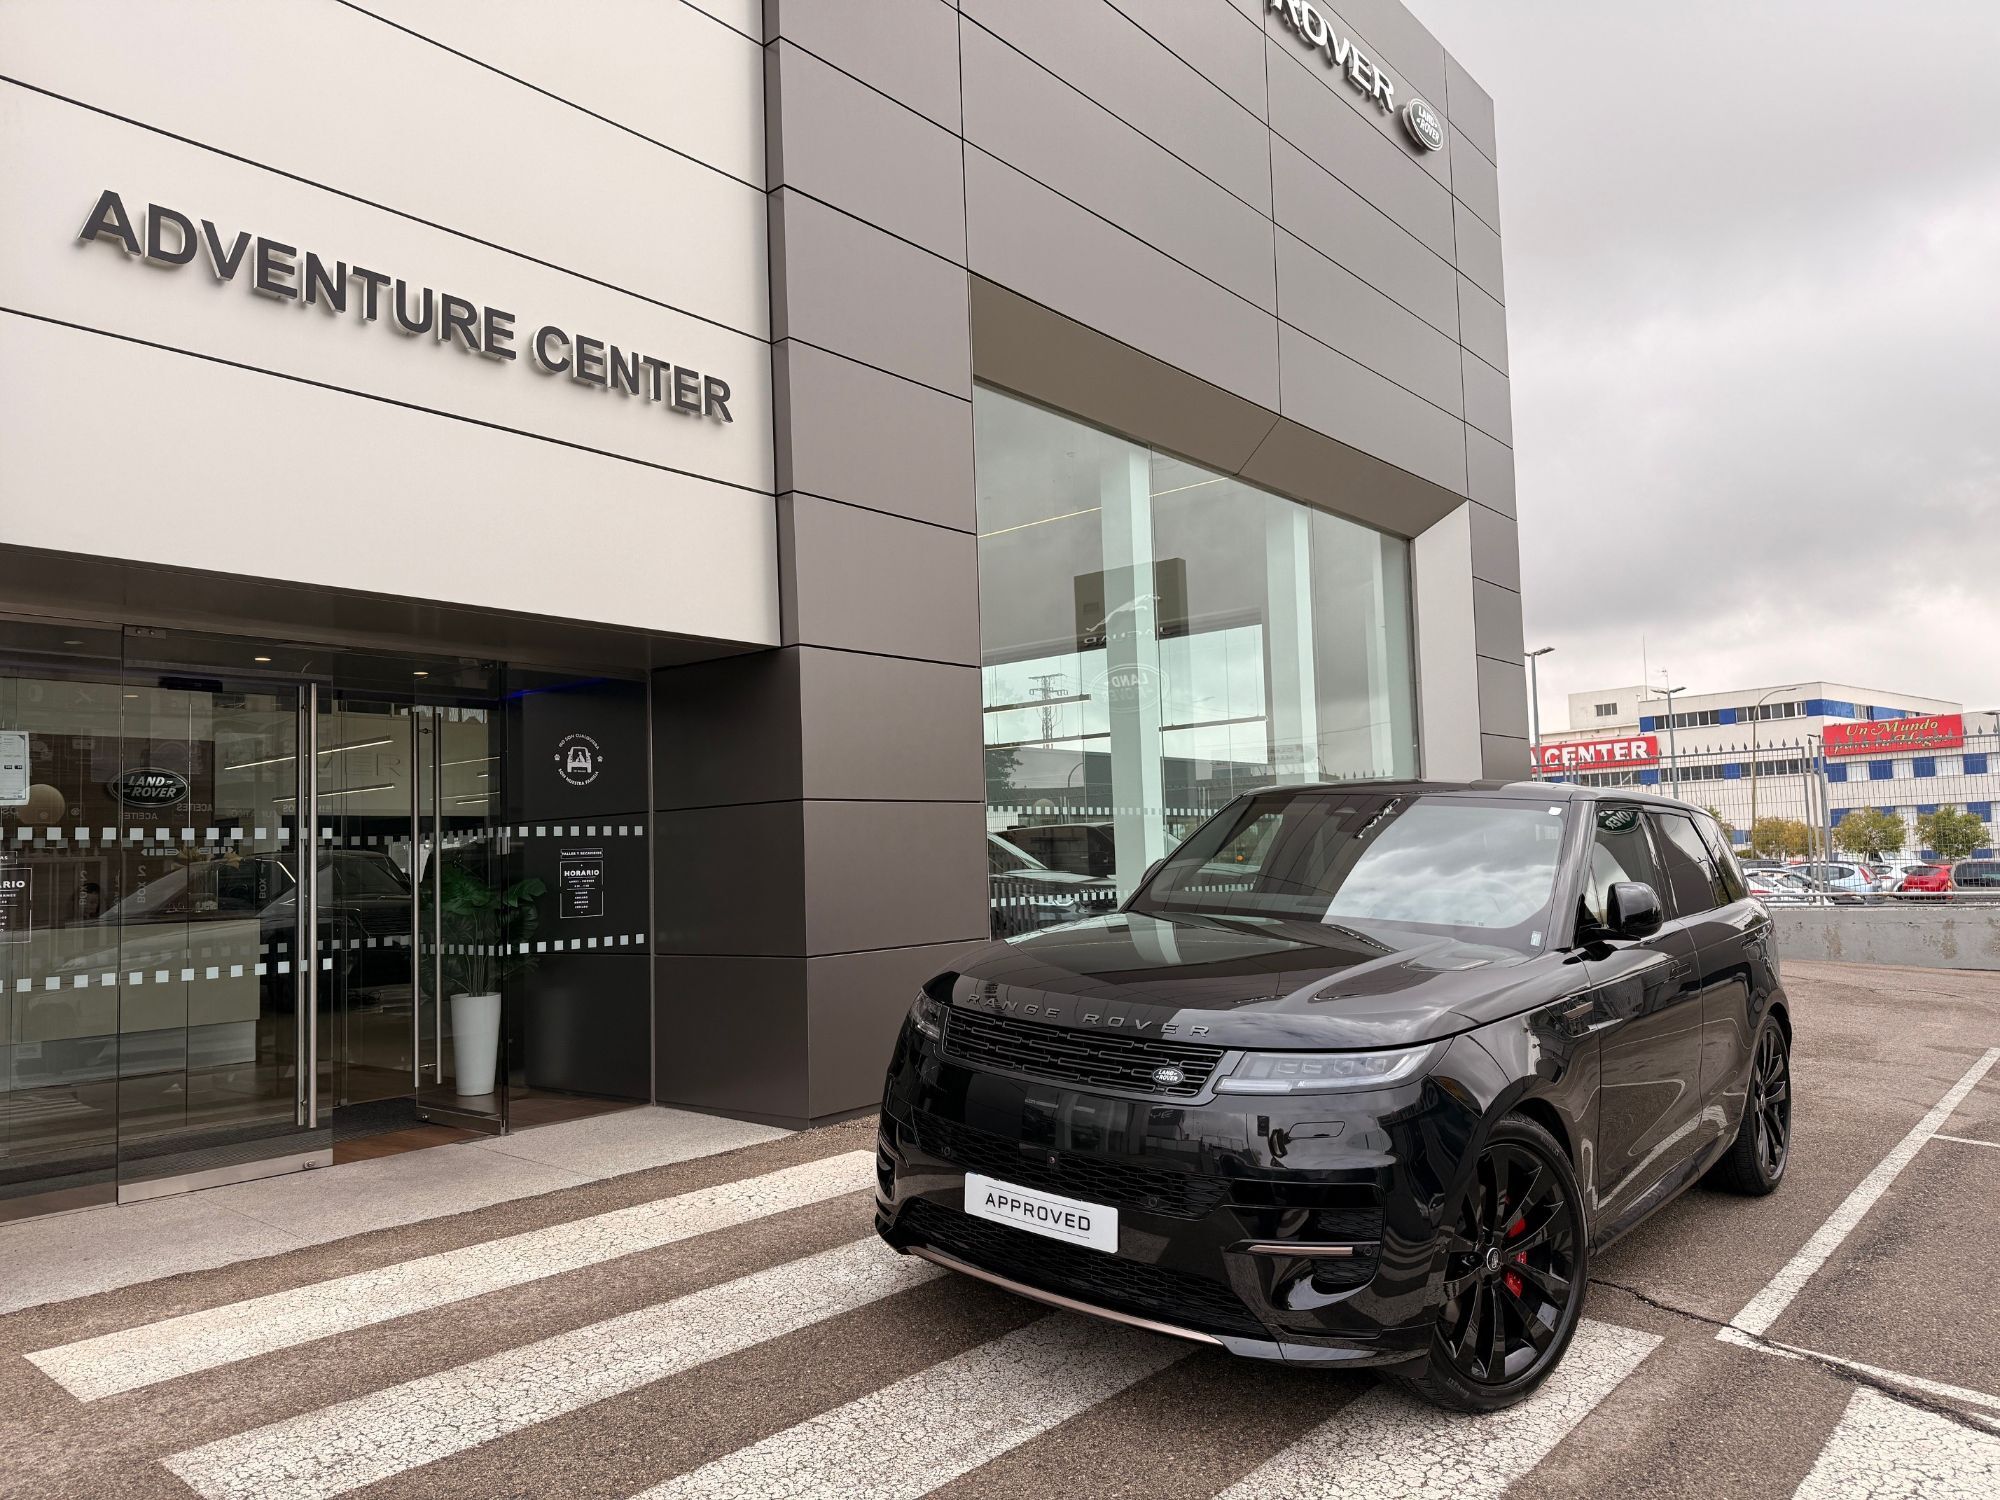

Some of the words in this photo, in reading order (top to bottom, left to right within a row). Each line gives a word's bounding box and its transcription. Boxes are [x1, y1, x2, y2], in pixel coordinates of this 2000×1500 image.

[1418, 105, 1436, 127] LAND
[1419, 118, 1440, 143] ROVER
[78, 188, 518, 362] ADVENTURE
[532, 325, 734, 424] CENTER
[1846, 724, 1868, 736] Un
[1871, 718, 1938, 736] Mundo
[1544, 739, 1649, 768] CENTER
[127, 775, 166, 787] LAND
[131, 786, 177, 798] ROVER
[564, 869, 600, 877] HORARIO
[967, 994, 1061, 1019] RANGE
[1082, 1013, 1210, 1038] ROVER
[985, 1192, 1091, 1232] APPROVED
